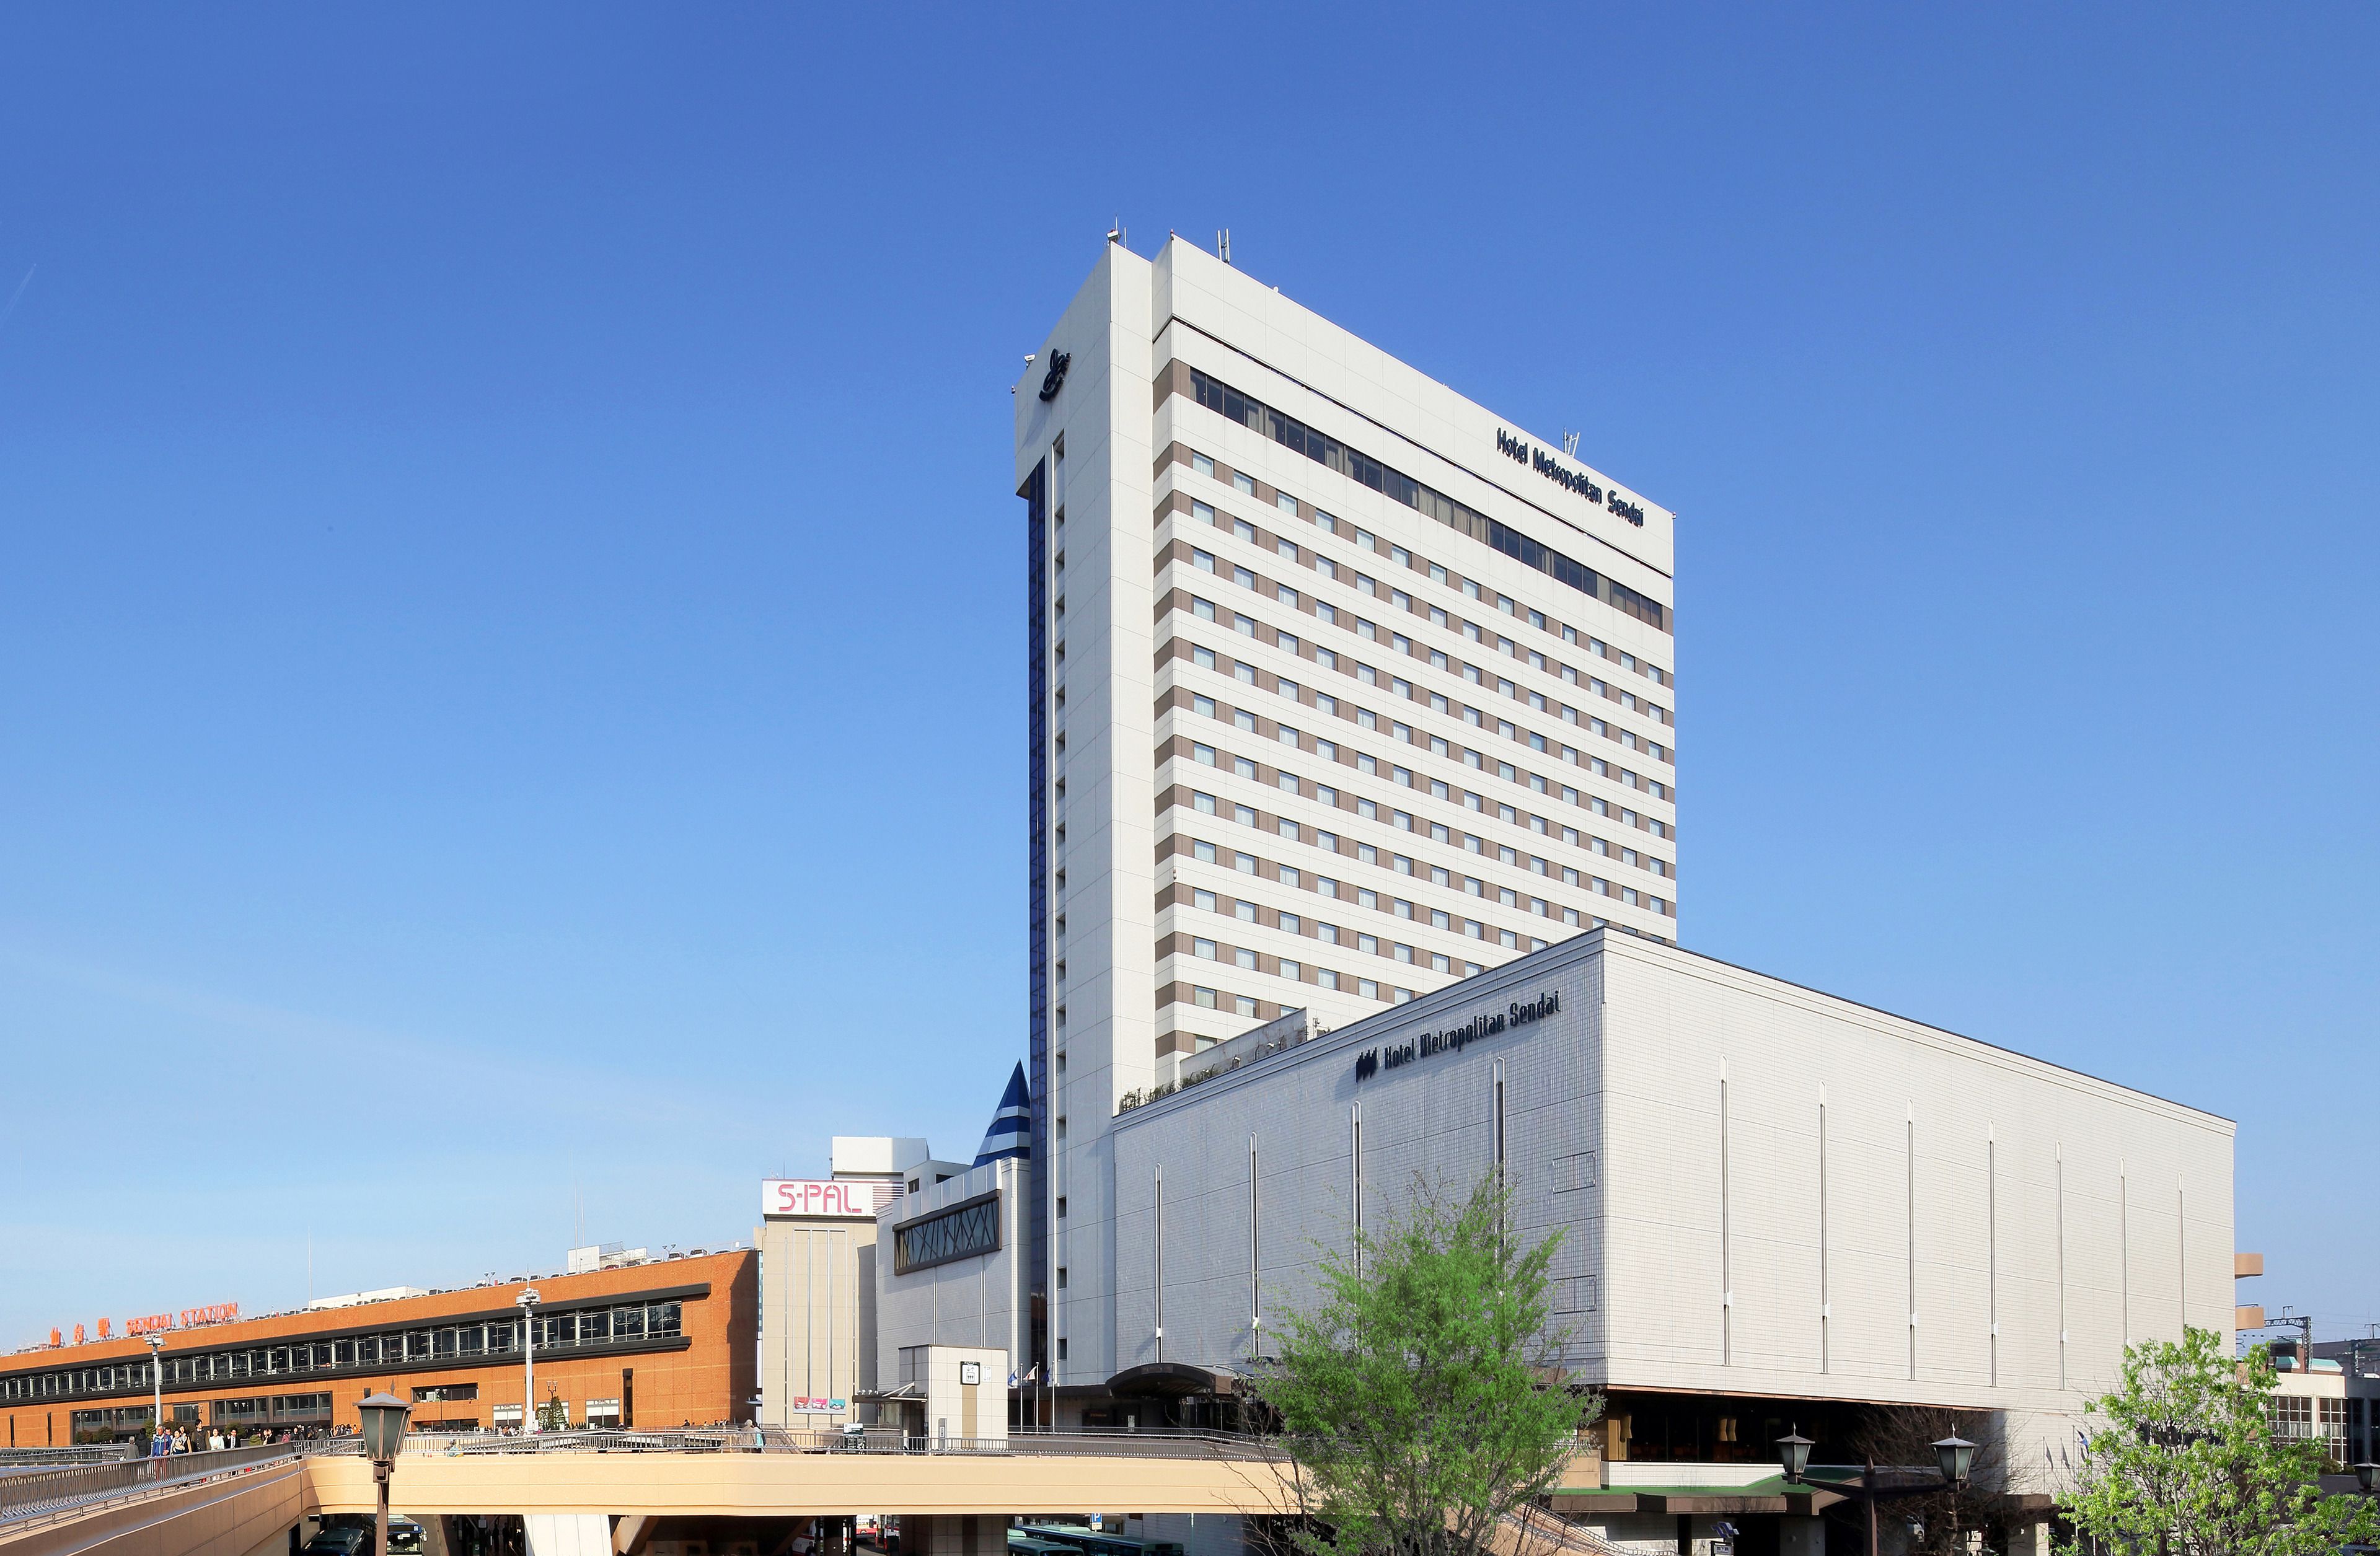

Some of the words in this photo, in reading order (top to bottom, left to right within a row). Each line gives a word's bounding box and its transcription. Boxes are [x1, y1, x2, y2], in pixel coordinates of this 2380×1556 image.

[1497, 428, 1528, 465] Hotel
[1533, 447, 1602, 505] Metropolitan
[1607, 490, 1643, 528] Sendai
[1384, 1038, 1416, 1069] Hotel
[1420, 1013, 1505, 1058] Metropolitan
[1510, 990, 1561, 1027] Sendai
[778, 1184, 862, 1213] S-PAL
[126, 1313, 172, 1336] SENDAI
[180, 1302, 237, 1325] STATION
